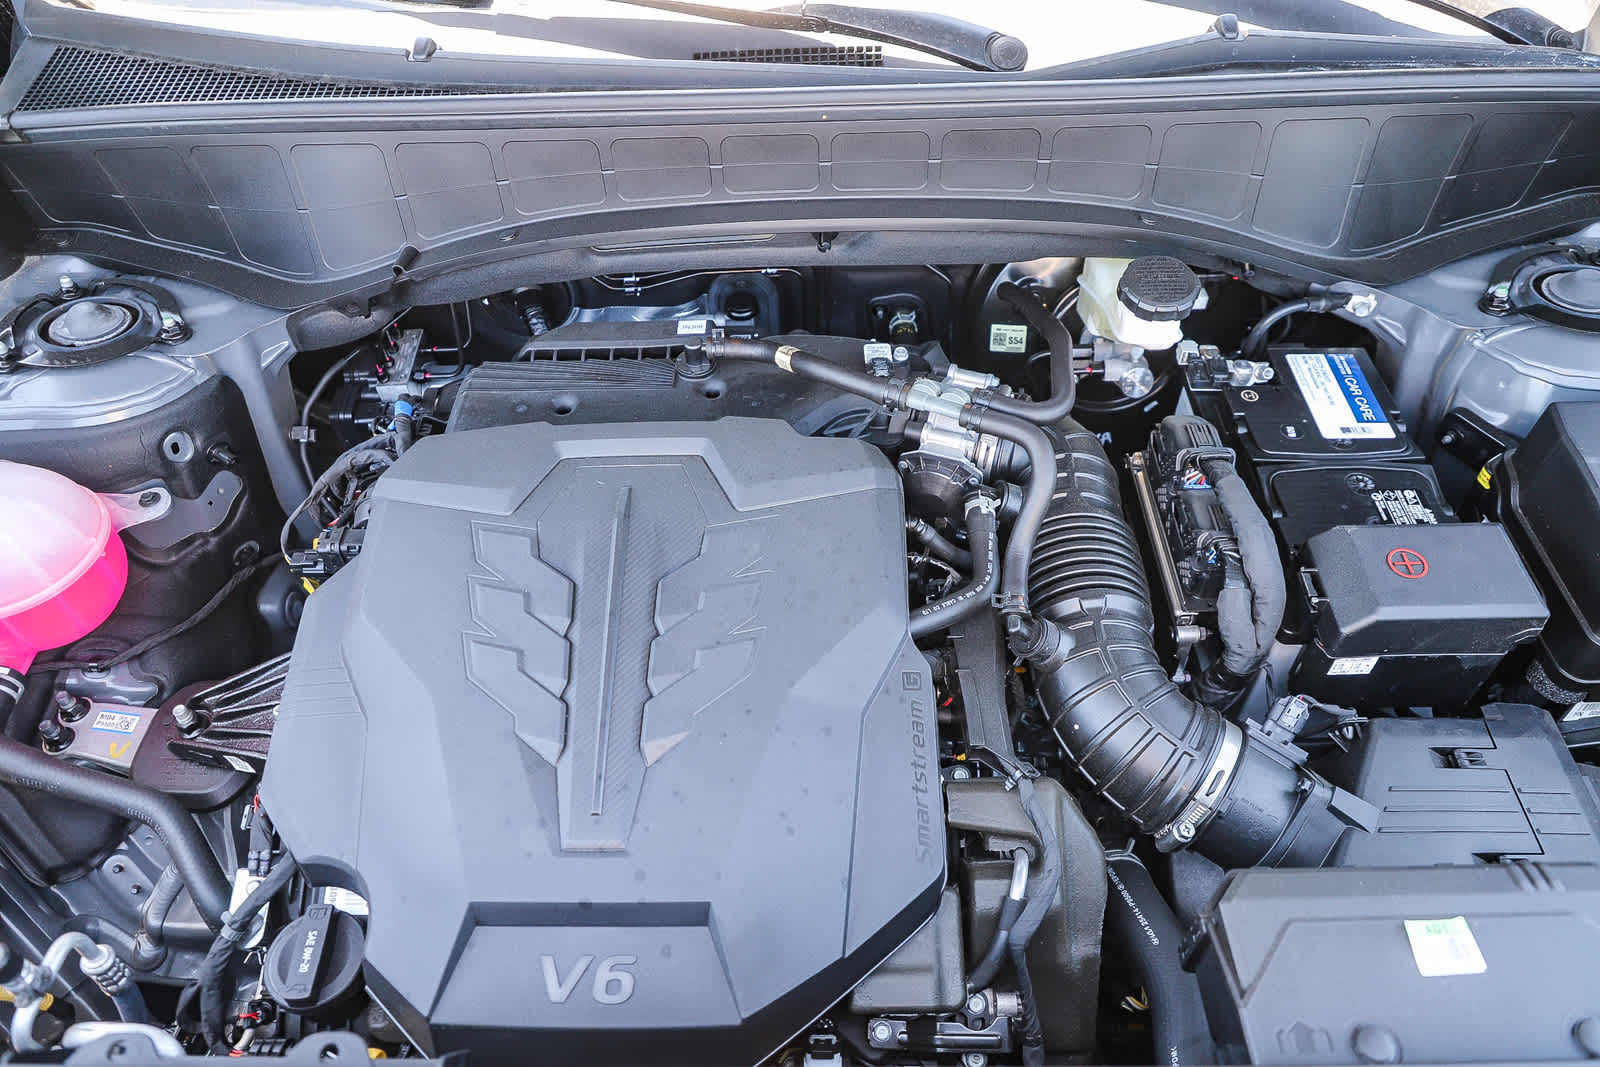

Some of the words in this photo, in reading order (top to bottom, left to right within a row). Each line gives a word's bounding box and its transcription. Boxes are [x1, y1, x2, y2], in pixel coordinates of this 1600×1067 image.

[1344, 377, 1363, 396] CAR
[1354, 397, 1377, 422] CARE
[910, 698, 933, 868] Smartstream
[305, 930, 318, 947] SAE
[540, 953, 638, 1006] V6
